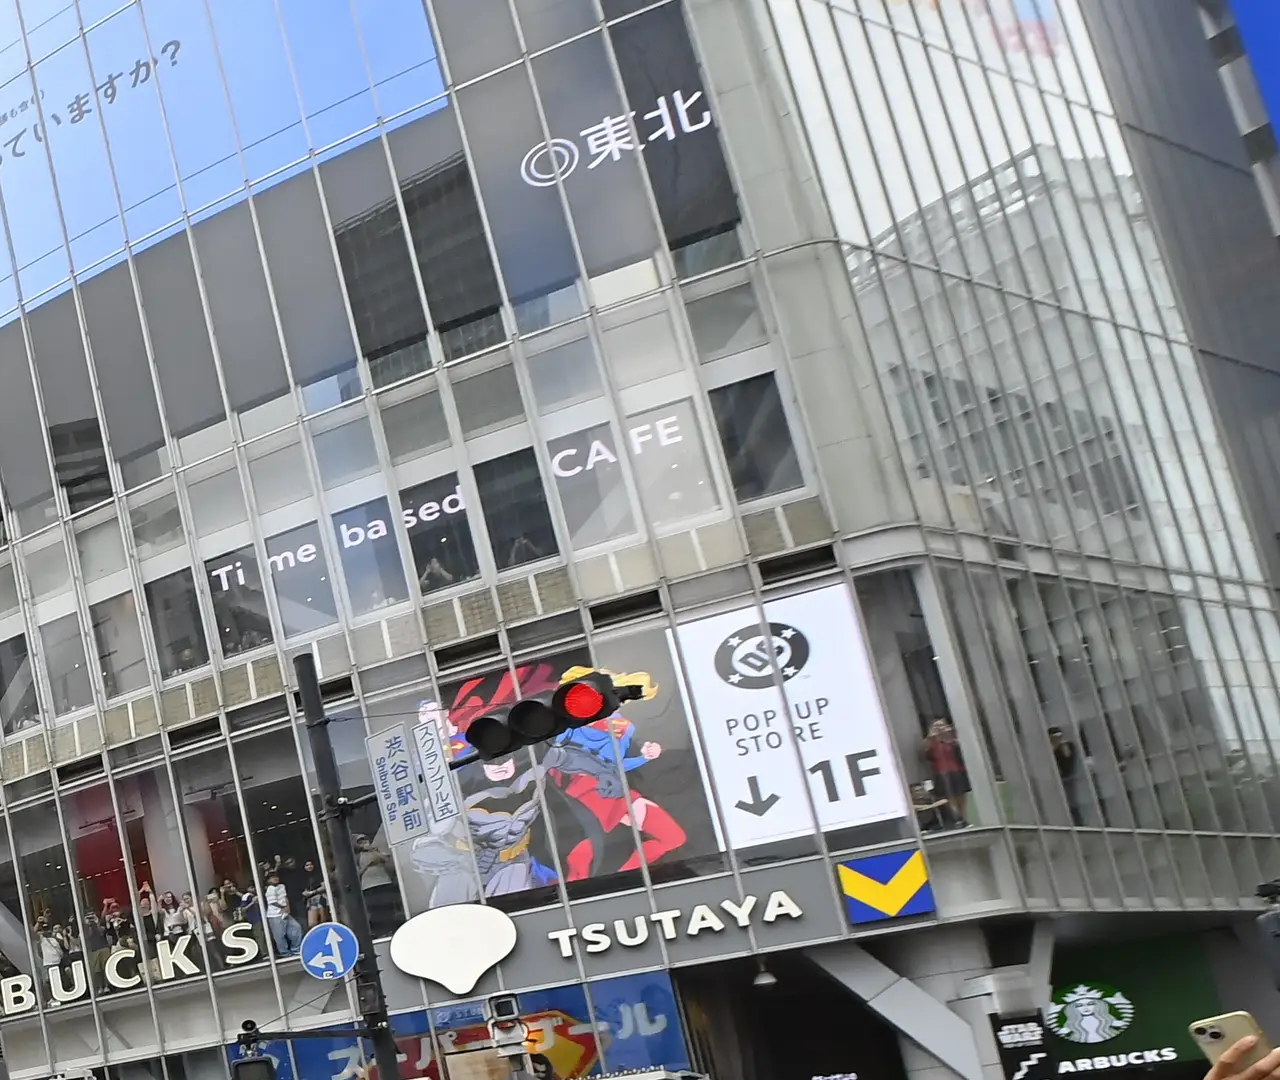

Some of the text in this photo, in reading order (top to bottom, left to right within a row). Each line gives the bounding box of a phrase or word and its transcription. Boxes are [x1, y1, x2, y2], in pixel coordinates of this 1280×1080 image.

[579, 88, 712, 169] 東北
[551, 415, 683, 478] CAFE
[211, 485, 466, 592] Time based
[726, 697, 829, 736] POP UP
[736, 721, 824, 757] STORE
[376, 756, 392, 800] Shibuya
[385, 735, 422, 832] 渋谷駅前
[420, 726, 453, 817] スクランブル式
[808, 749, 881, 803] 1F
[547, 890, 803, 959] TSUTAYA
[1057, 1047, 1178, 1075] ARBUCKS
